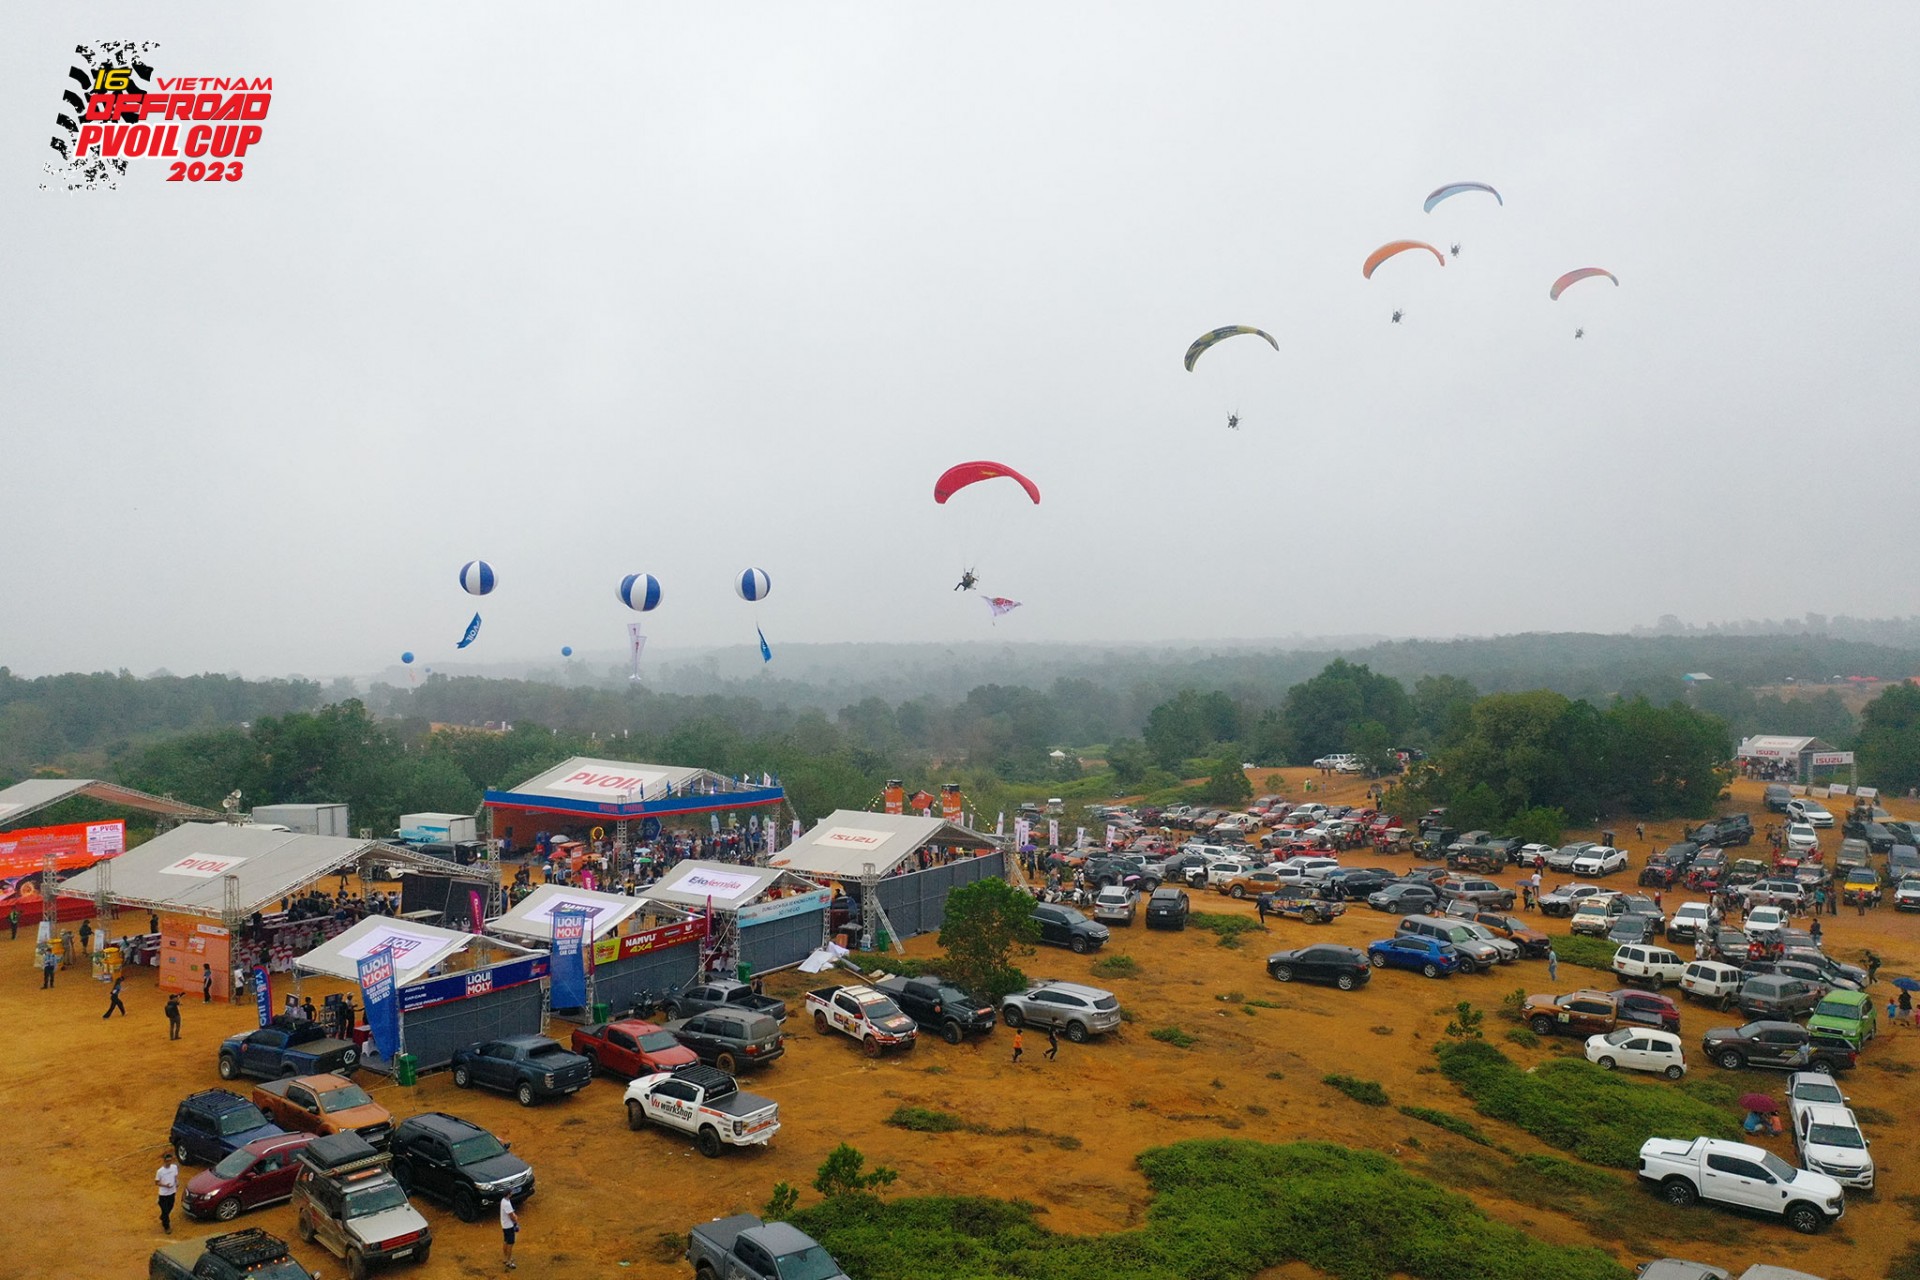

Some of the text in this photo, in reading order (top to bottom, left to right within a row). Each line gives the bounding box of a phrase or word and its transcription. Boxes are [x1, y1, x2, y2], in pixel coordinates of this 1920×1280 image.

[565, 772, 643, 790] PVOIL
[831, 833, 878, 844] ISUZU
[174, 858, 229, 873] PVOIL
[557, 917, 582, 927] LIQUI
[557, 927, 581, 938] MOLY
[625, 933, 657, 947] NAMVU
[467, 972, 490, 985] LIQUI
[467, 981, 491, 996] MOLY
[660, 1101, 693, 1121] workshop
